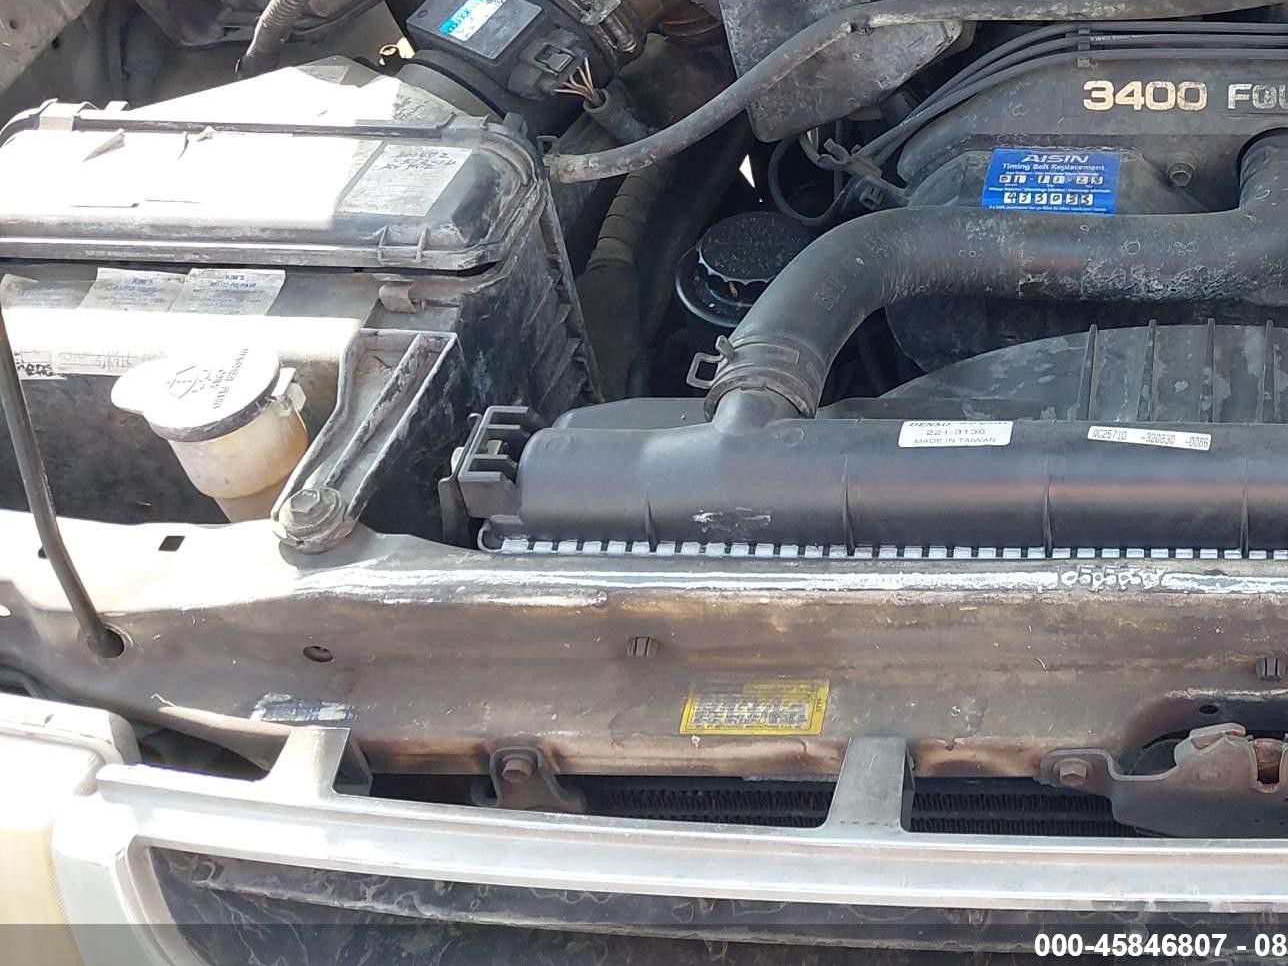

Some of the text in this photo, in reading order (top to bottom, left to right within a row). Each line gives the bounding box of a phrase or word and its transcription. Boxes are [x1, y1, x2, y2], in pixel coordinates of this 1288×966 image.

[1082, 80, 1209, 111] 3400
[1020, 154, 1090, 164] AISIN
[1002, 162, 1106, 172] Timing Belt Replacement
[959, 436, 997, 444] TAIWAN
